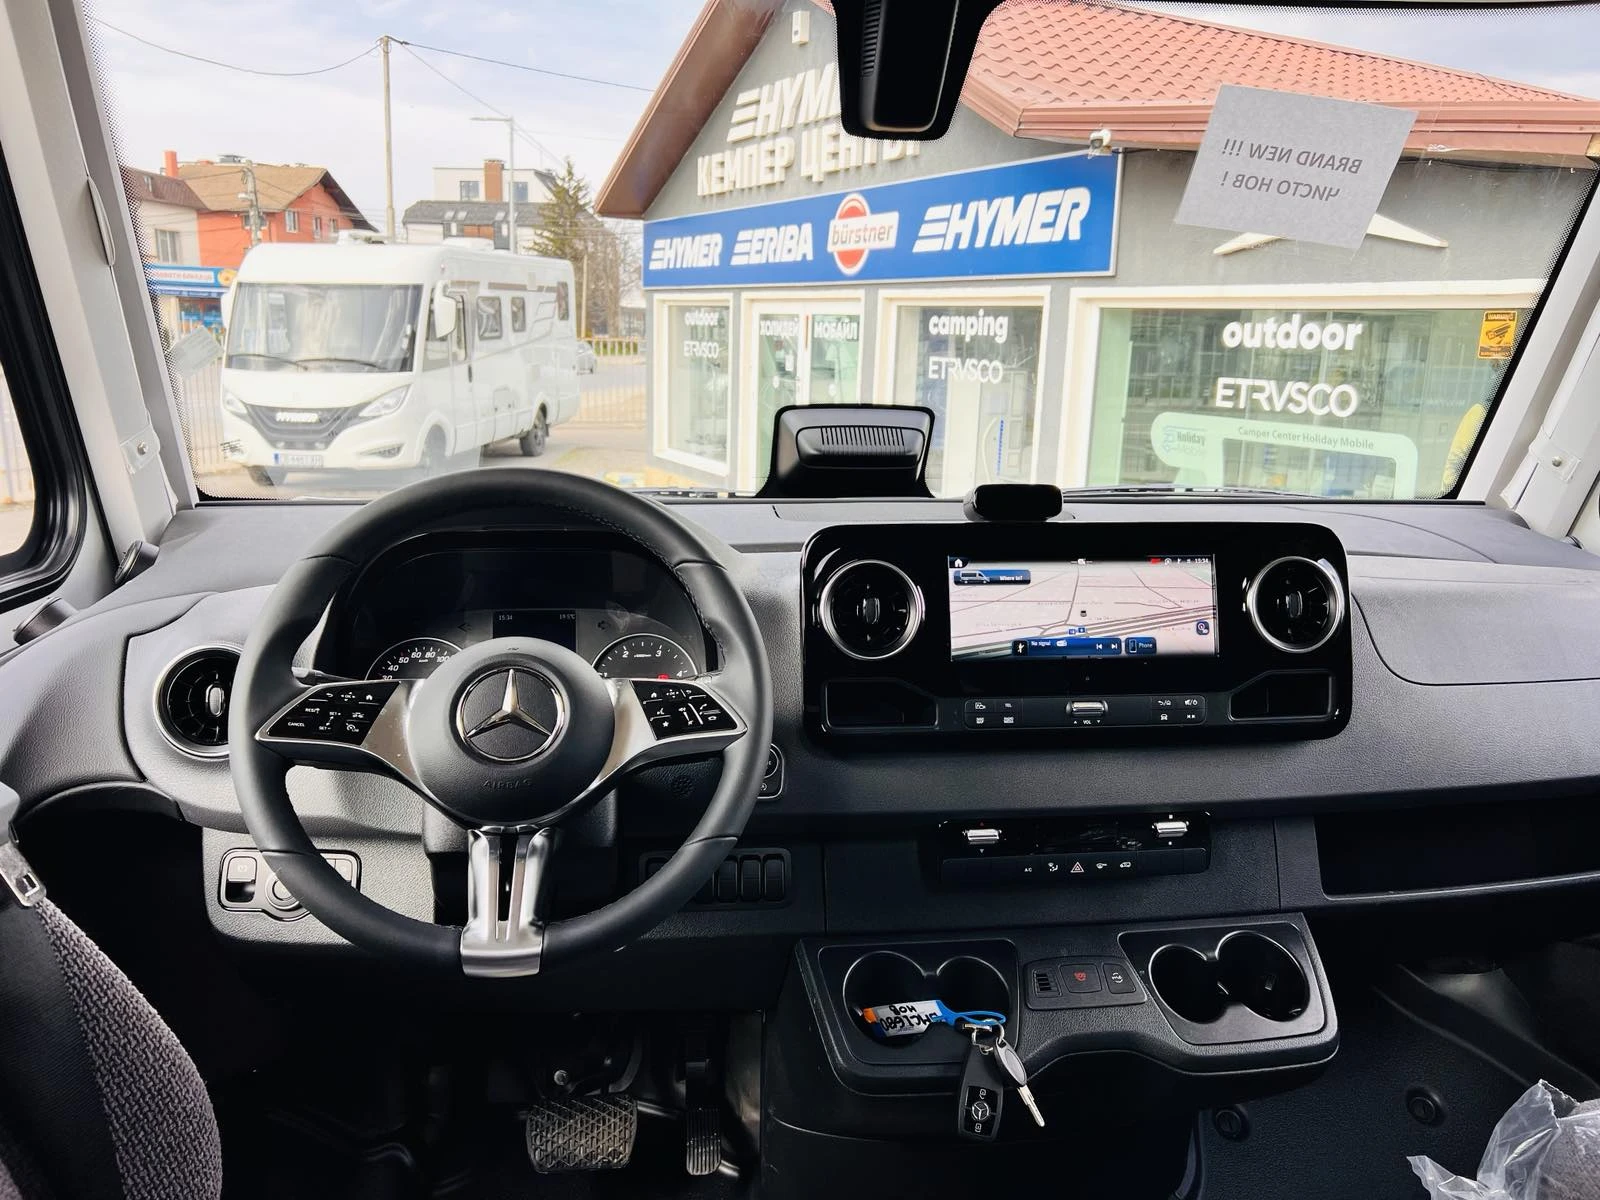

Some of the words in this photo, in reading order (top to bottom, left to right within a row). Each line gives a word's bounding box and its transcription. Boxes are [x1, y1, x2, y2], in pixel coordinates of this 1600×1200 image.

[728, 62, 842, 143] HYM
[697, 136, 795, 196] КЕМПЕР
[913, 187, 1091, 254] HYMER
[730, 223, 814, 266] ERIBA
[830, 221, 894, 248] bürstner
[648, 233, 723, 270] HYMER
[813, 318, 859, 341] МОБАЙЛ
[928, 309, 1009, 344] camping
[1222, 314, 1363, 353] outdoor
[1238, 426, 1270, 440] Camper
[1272, 430, 1302, 442] Center
[1303, 432, 1338, 448] Holiday
[1340, 435, 1375, 450] Mobile
[398, 656, 410, 664] 50
[411, 651, 422, 659] 60
[622, 650, 629, 658] 2
[655, 649, 662, 657] 3
[388, 664, 399, 672] 40
[483, 779, 532, 789] AIRBA
